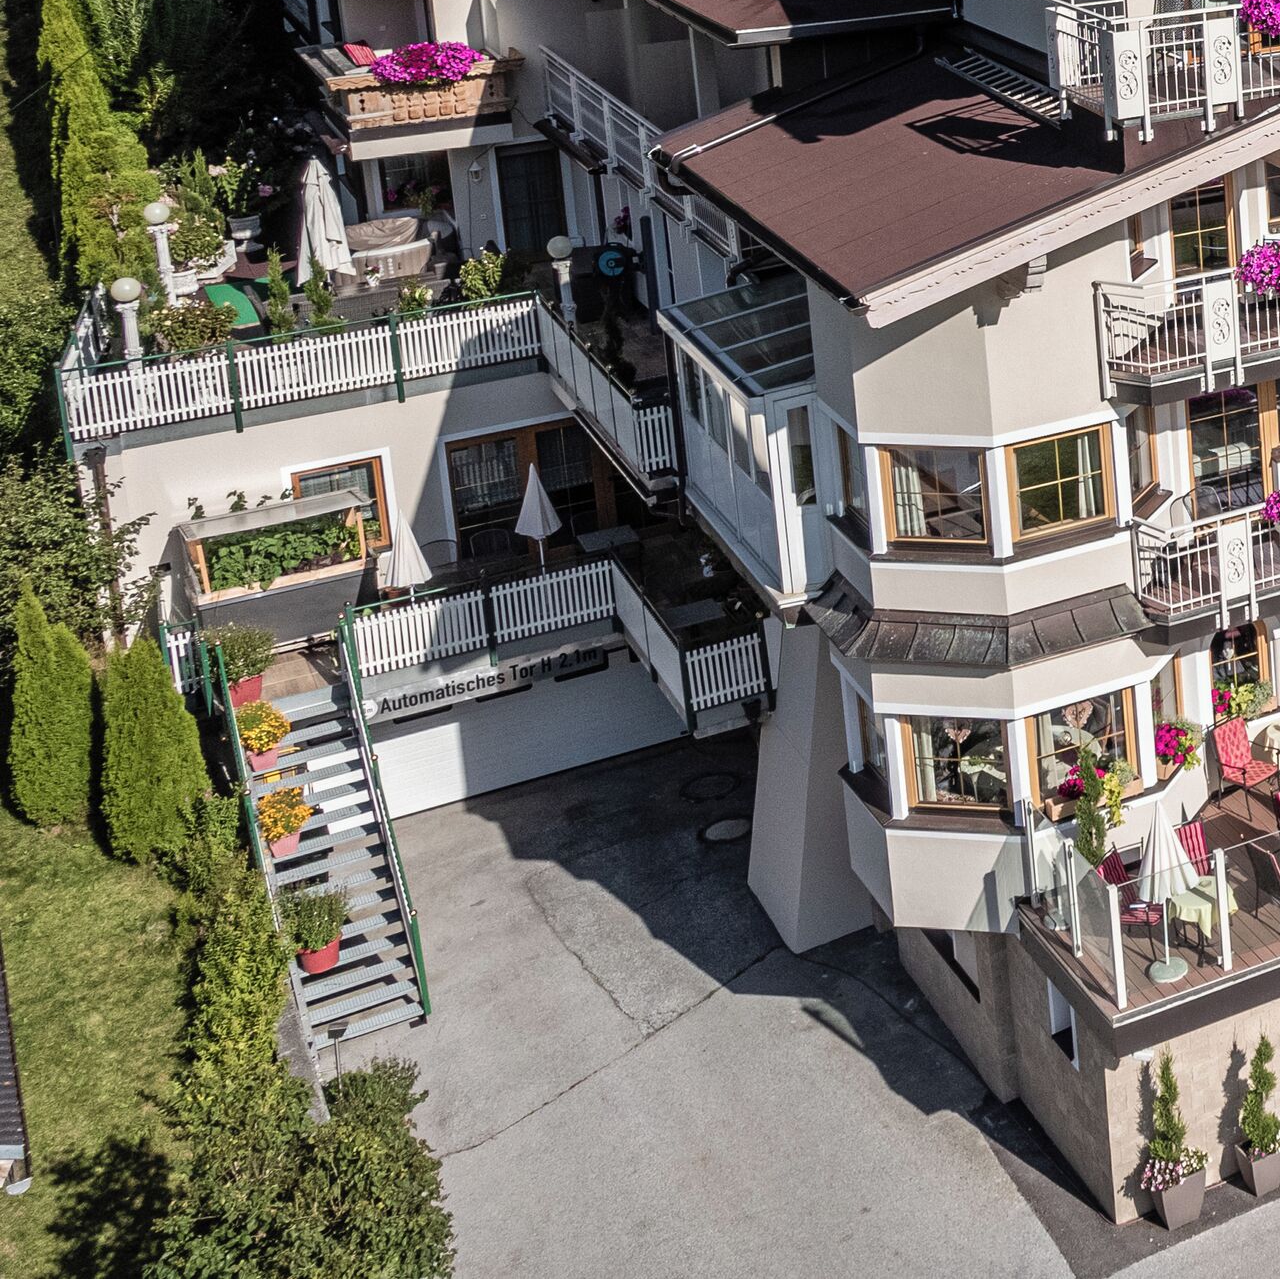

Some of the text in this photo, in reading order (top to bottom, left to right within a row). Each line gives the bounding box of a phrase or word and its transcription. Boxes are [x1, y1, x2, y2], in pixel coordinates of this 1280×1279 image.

[380, 672, 505, 714] Automatisches
[509, 664, 536, 681] Tor
[541, 656, 552, 673] H
